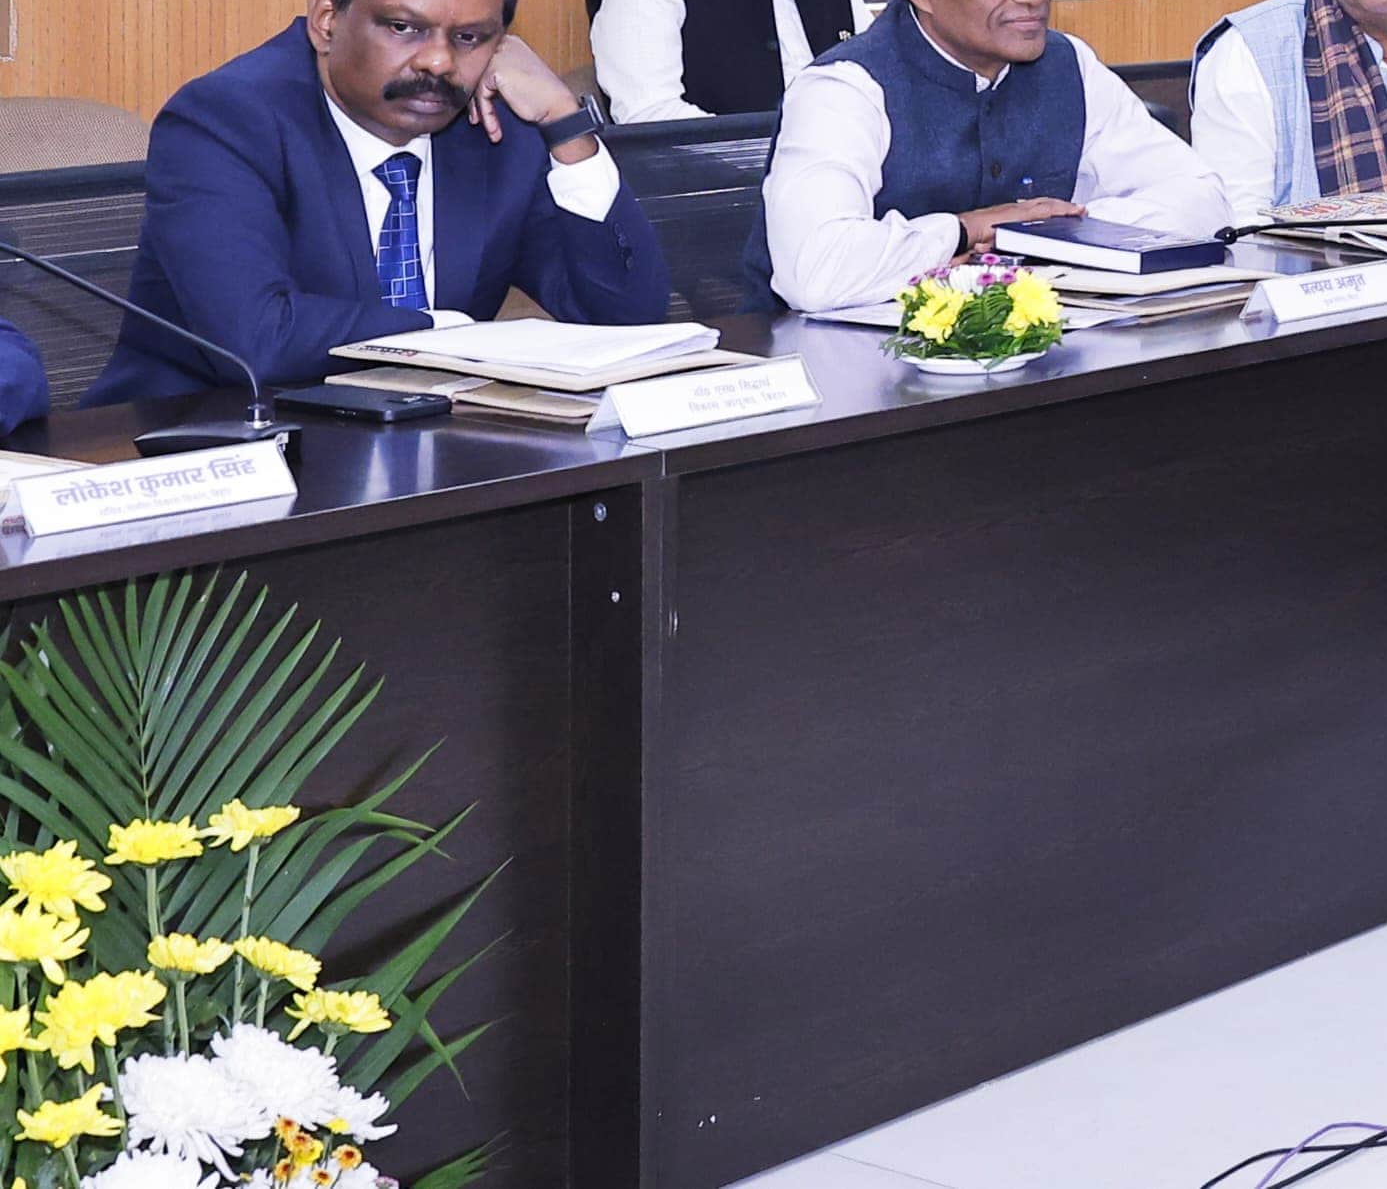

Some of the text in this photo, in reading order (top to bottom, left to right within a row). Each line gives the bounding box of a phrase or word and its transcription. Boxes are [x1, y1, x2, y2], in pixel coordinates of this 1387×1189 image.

[51, 477, 132, 507] लोकेश
[135, 467, 203, 493] कुमार
[208, 454, 256, 480] सिंह
